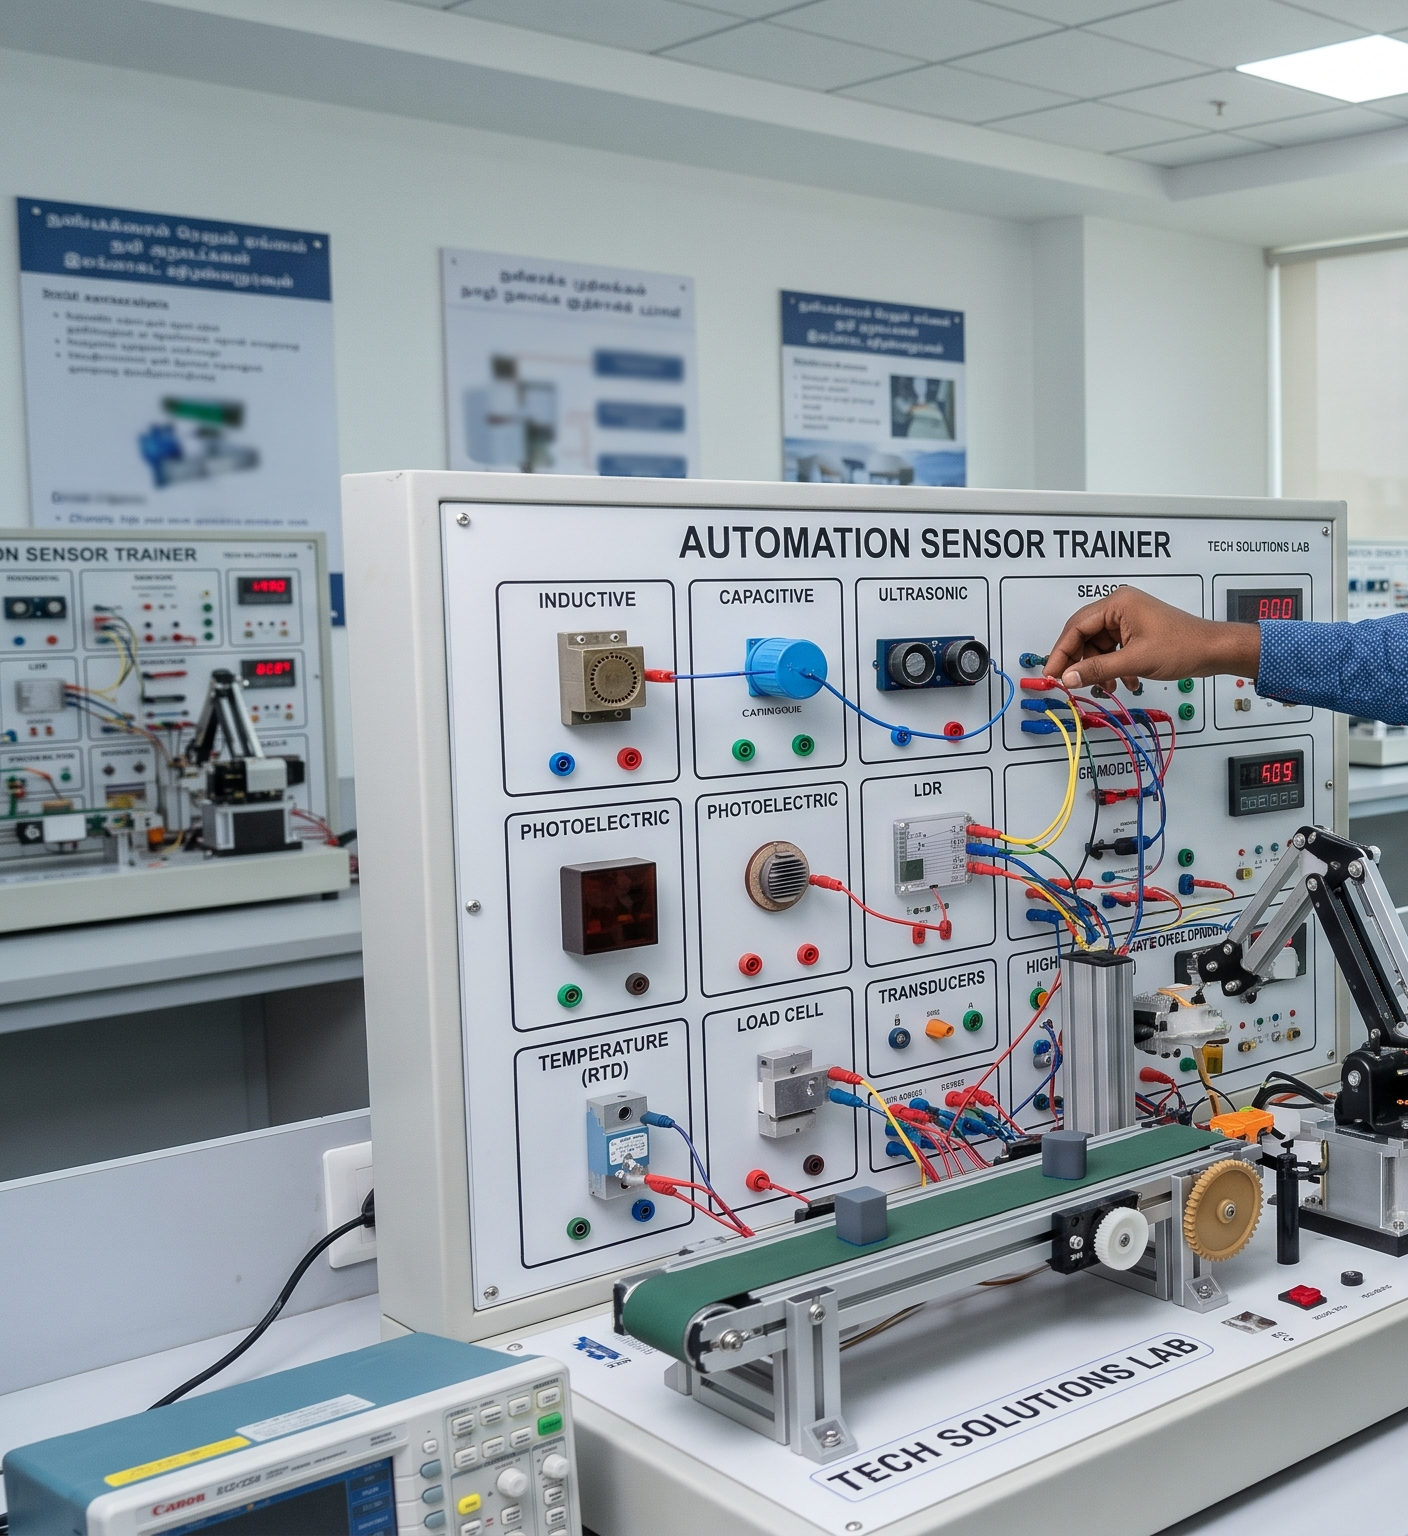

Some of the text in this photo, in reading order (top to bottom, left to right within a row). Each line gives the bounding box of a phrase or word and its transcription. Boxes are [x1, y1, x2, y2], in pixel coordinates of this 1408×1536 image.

[679, 525, 1172, 559] AUTOMATION SENSOR TRAINER
[1207, 541, 1310, 553] TECH SOLUTIONS LAB
[26, 547, 109, 562] SENSOR
[114, 547, 198, 562] TRAINER
[539, 591, 636, 609] INDUCTIVE
[719, 587, 814, 605] CAPACITIVE
[878, 586, 968, 602] ULTRASONIC
[1258, 598, 1293, 619] 800
[913, 781, 943, 798] LDR
[707, 791, 839, 820] PHOTOELECTRIC
[520, 809, 670, 841] PHOTOELECTRIC
[1026, 955, 1058, 975] HIGH
[878, 970, 985, 1004] TRANSDUCERS
[737, 1002, 824, 1033] LOAD CELL
[538, 1031, 669, 1072] TEMPERATURE
[581, 1061, 629, 1088] (RTD)
[826, 1338, 1199, 1492] TECH SOLUTIONS LAB
